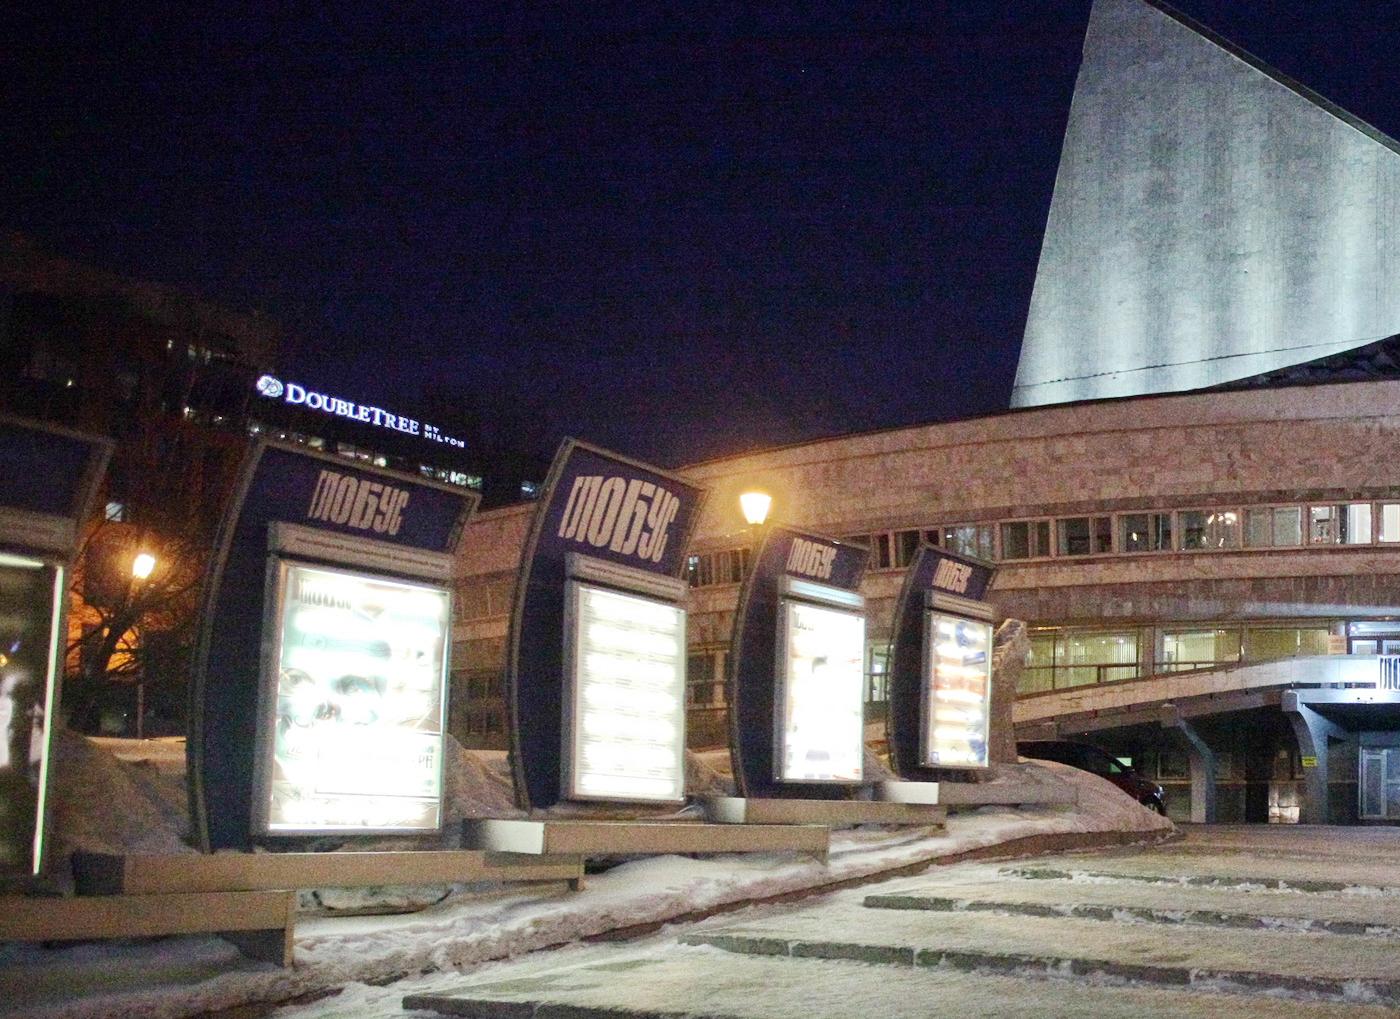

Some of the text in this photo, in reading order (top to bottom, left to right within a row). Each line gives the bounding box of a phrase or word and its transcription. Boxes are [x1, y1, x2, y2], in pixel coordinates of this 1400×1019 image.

[424, 423, 440, 434] BY
[424, 431, 465, 448] HILTON
[307, 470, 410, 536] ГЛОБУС
[558, 475, 680, 563] ГЛОБУС
